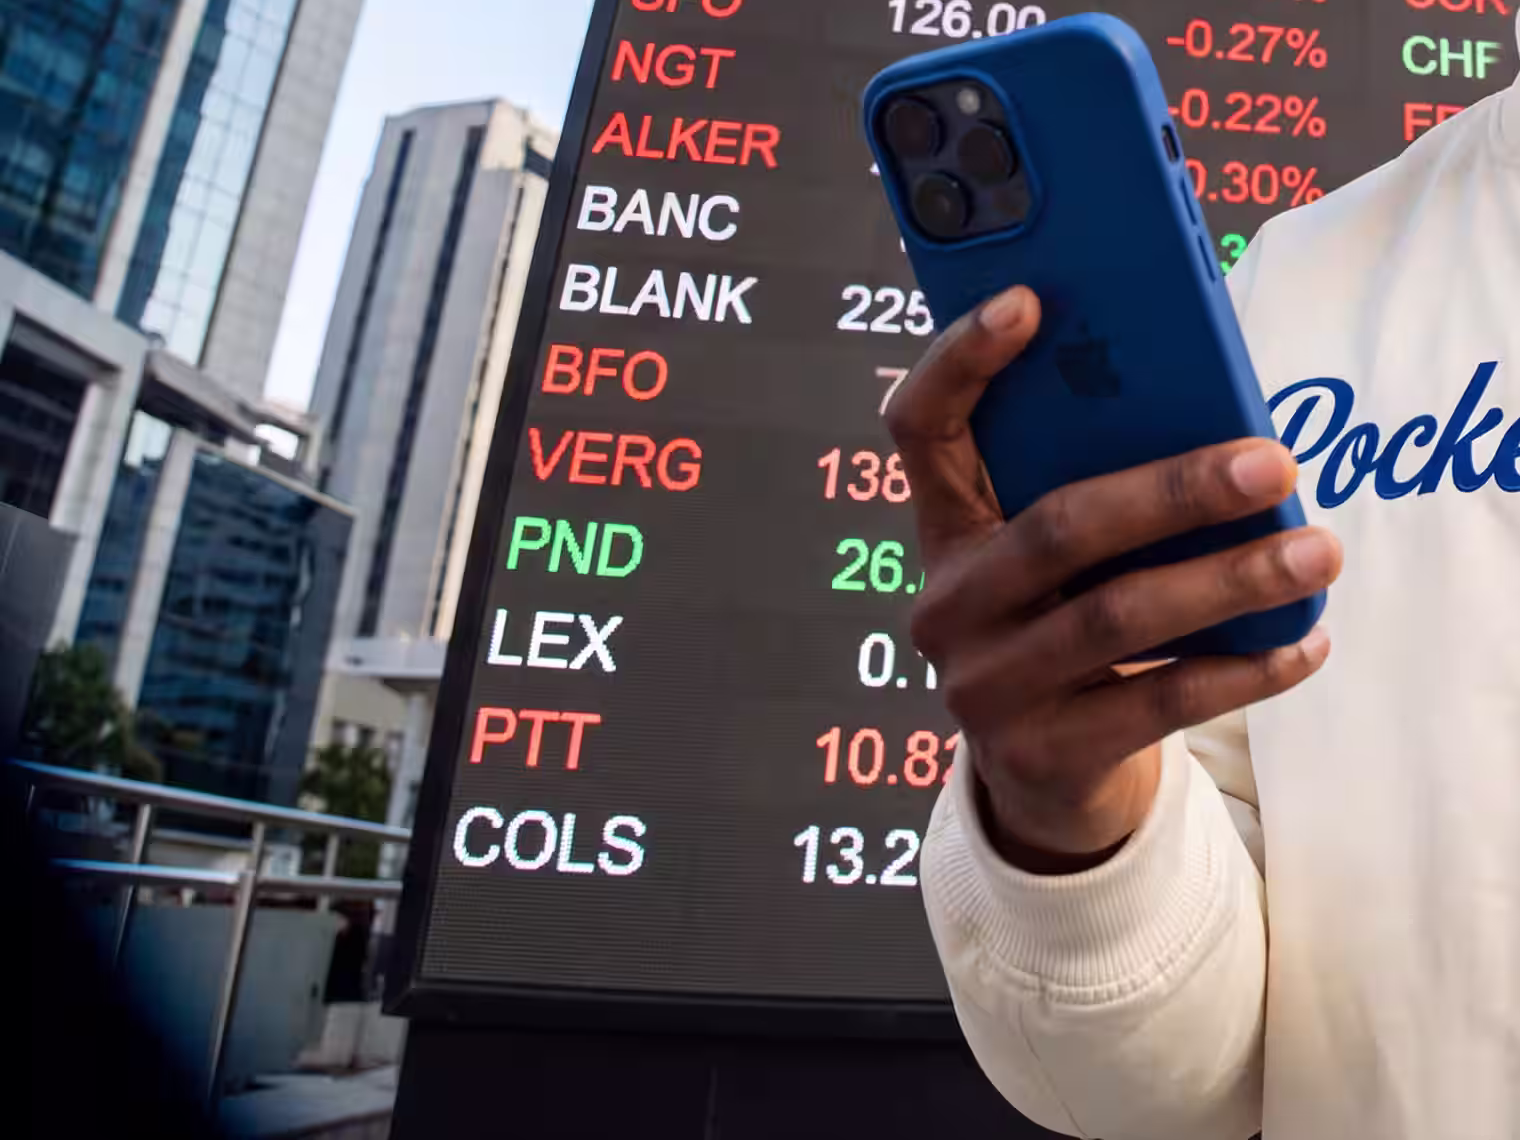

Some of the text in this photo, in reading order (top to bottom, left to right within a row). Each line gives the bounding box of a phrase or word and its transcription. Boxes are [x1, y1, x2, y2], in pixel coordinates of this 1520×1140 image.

[612, 40, 736, 88] NGT
[1167, 19, 1328, 68] -0.27%
[592, 112, 780, 168] ALKER
[577, 186, 739, 240] BANC
[560, 264, 757, 324] BLANK
[542, 344, 668, 400] BFO
[528, 428, 702, 491] VERG
[507, 517, 643, 577] PND
[488, 609, 623, 672] LEX
[470, 707, 601, 770] PTT
[453, 807, 646, 875] COLS
